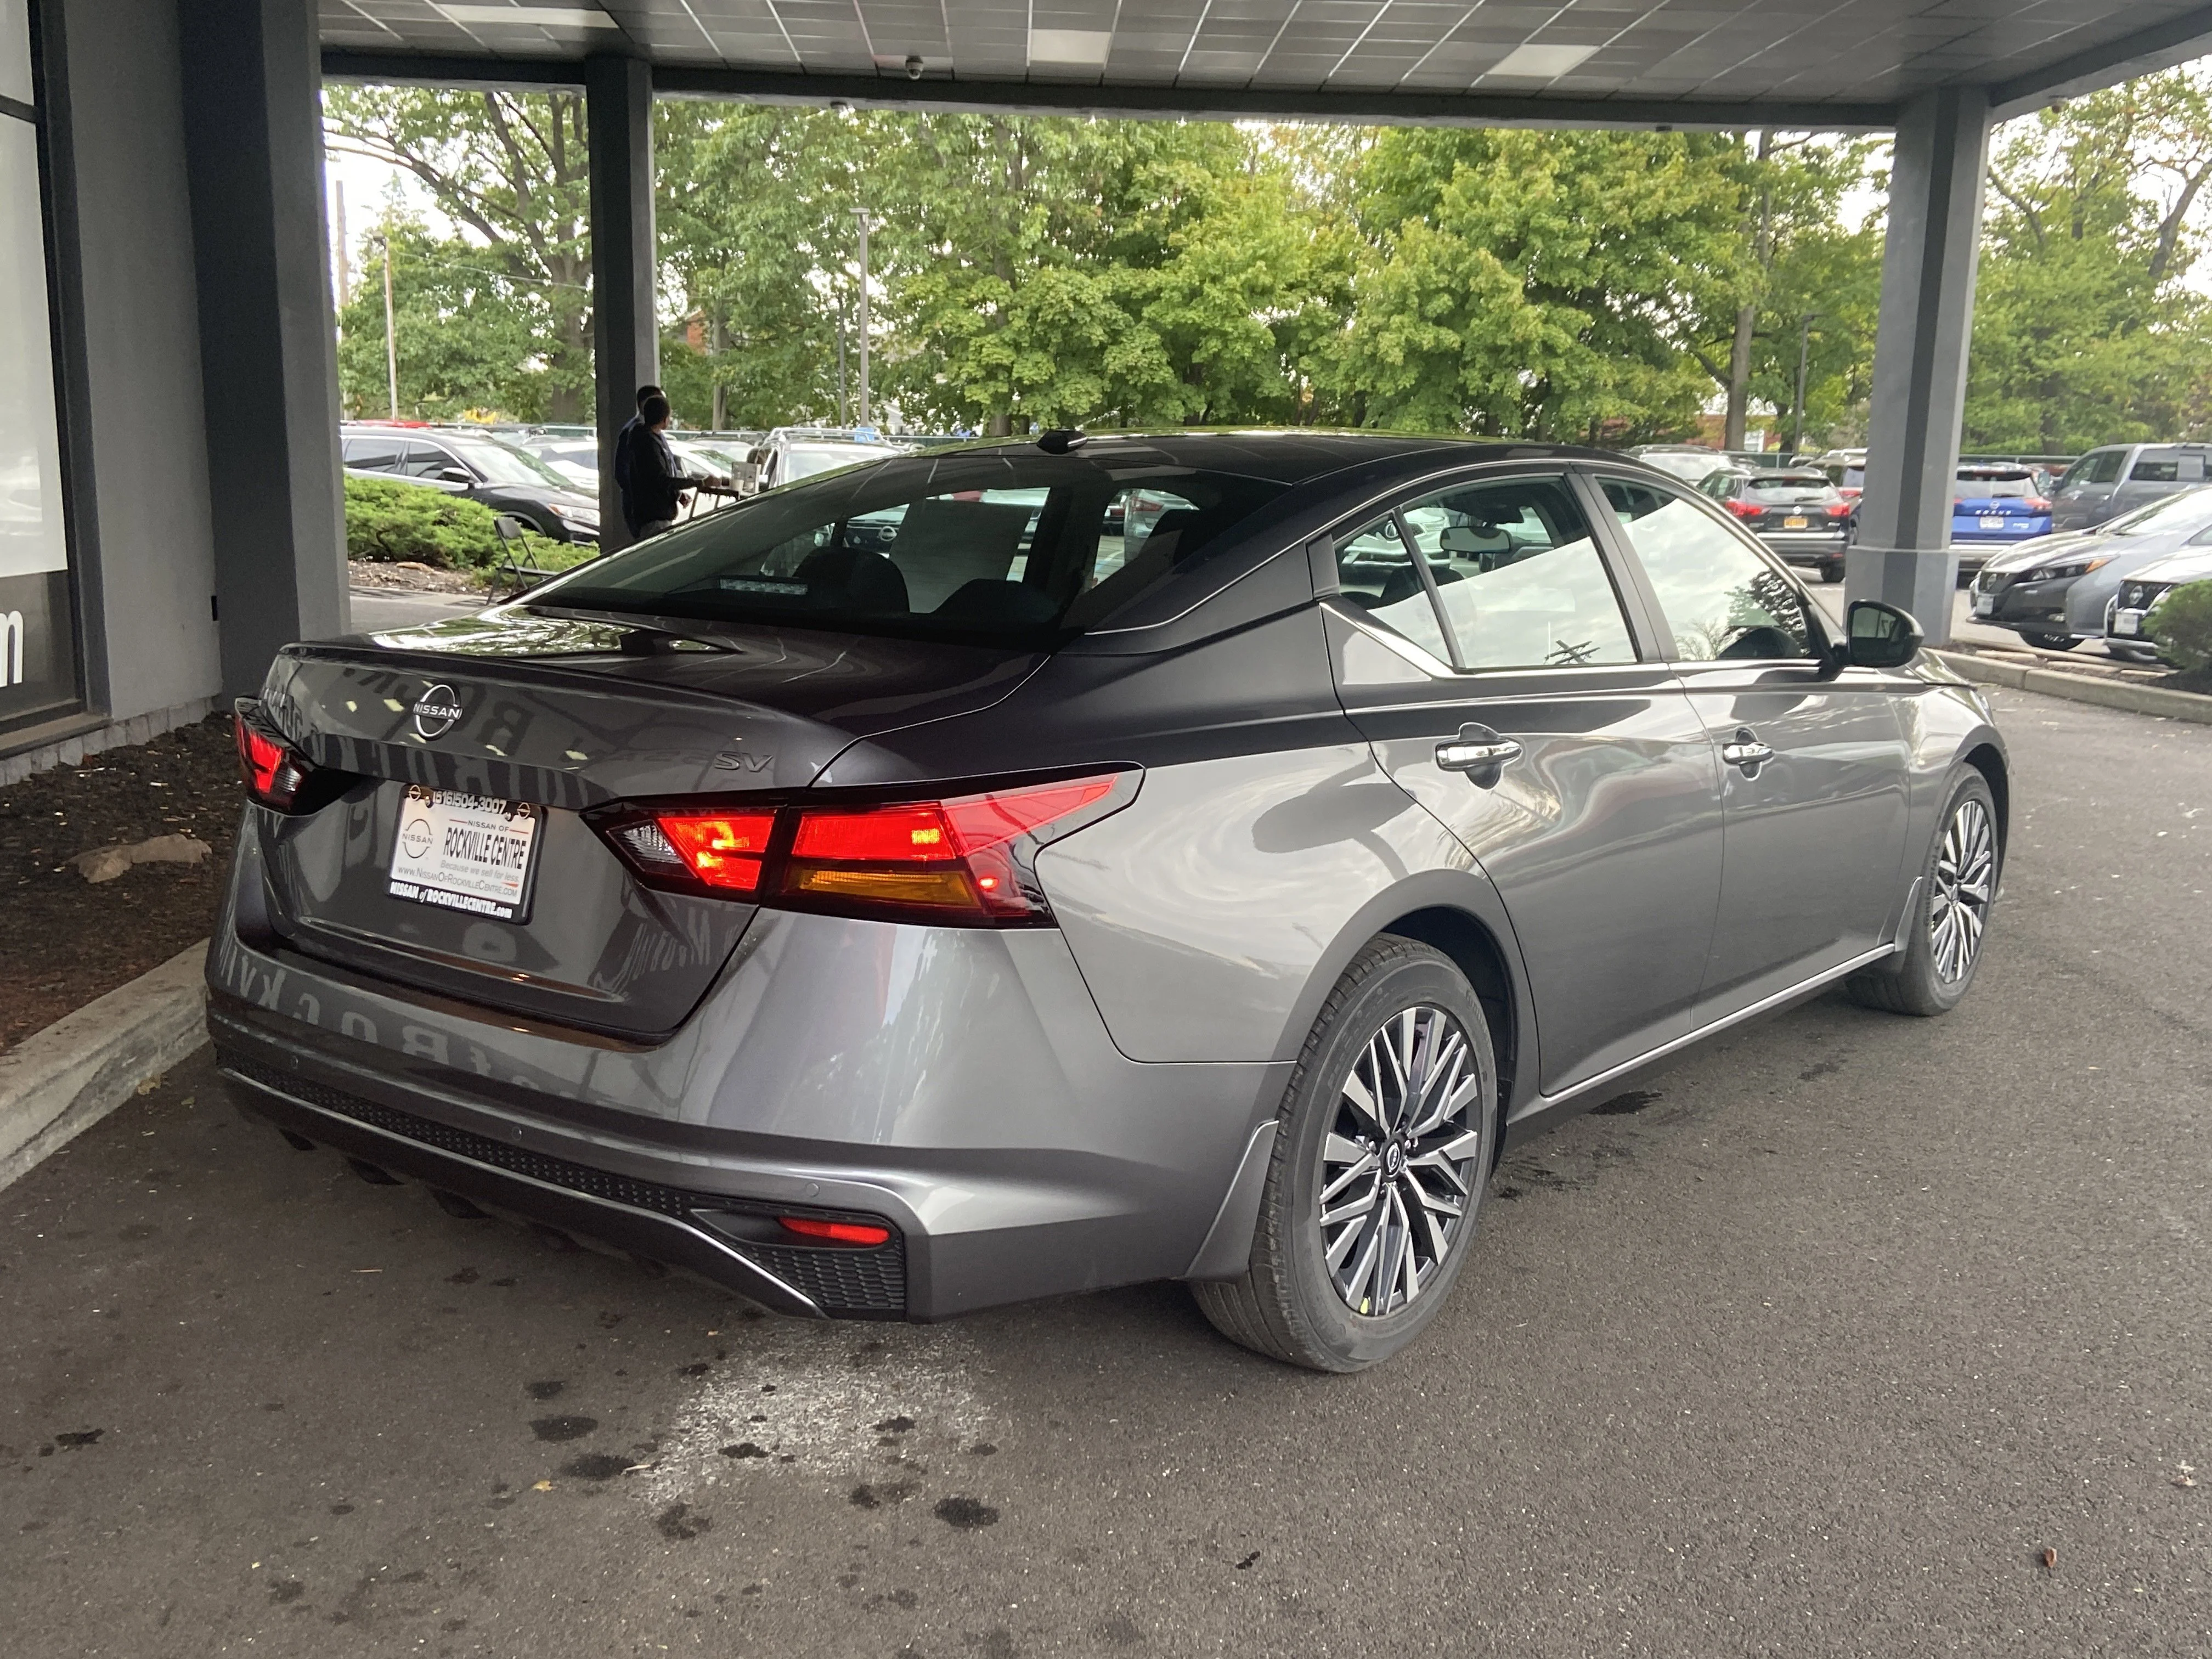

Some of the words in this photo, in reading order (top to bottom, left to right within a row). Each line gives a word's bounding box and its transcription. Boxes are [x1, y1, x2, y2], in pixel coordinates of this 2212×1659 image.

[413, 703, 460, 718] NISSAN
[714, 751, 773, 773] SV
[467, 820, 496, 830] NISSAN
[402, 833, 433, 845] NISSAN
[443, 827, 492, 864] ROCKVILLE
[490, 834, 527, 870] CENTRE
[441, 860, 469, 873] Because
[470, 866, 479, 874] we
[482, 868, 493, 878] sell
[494, 869, 505, 880] for
[390, 881, 420, 899] NISSAN
[419, 889, 428, 903] of
[427, 888, 513, 919] ROCKVILLECENTRE.com
